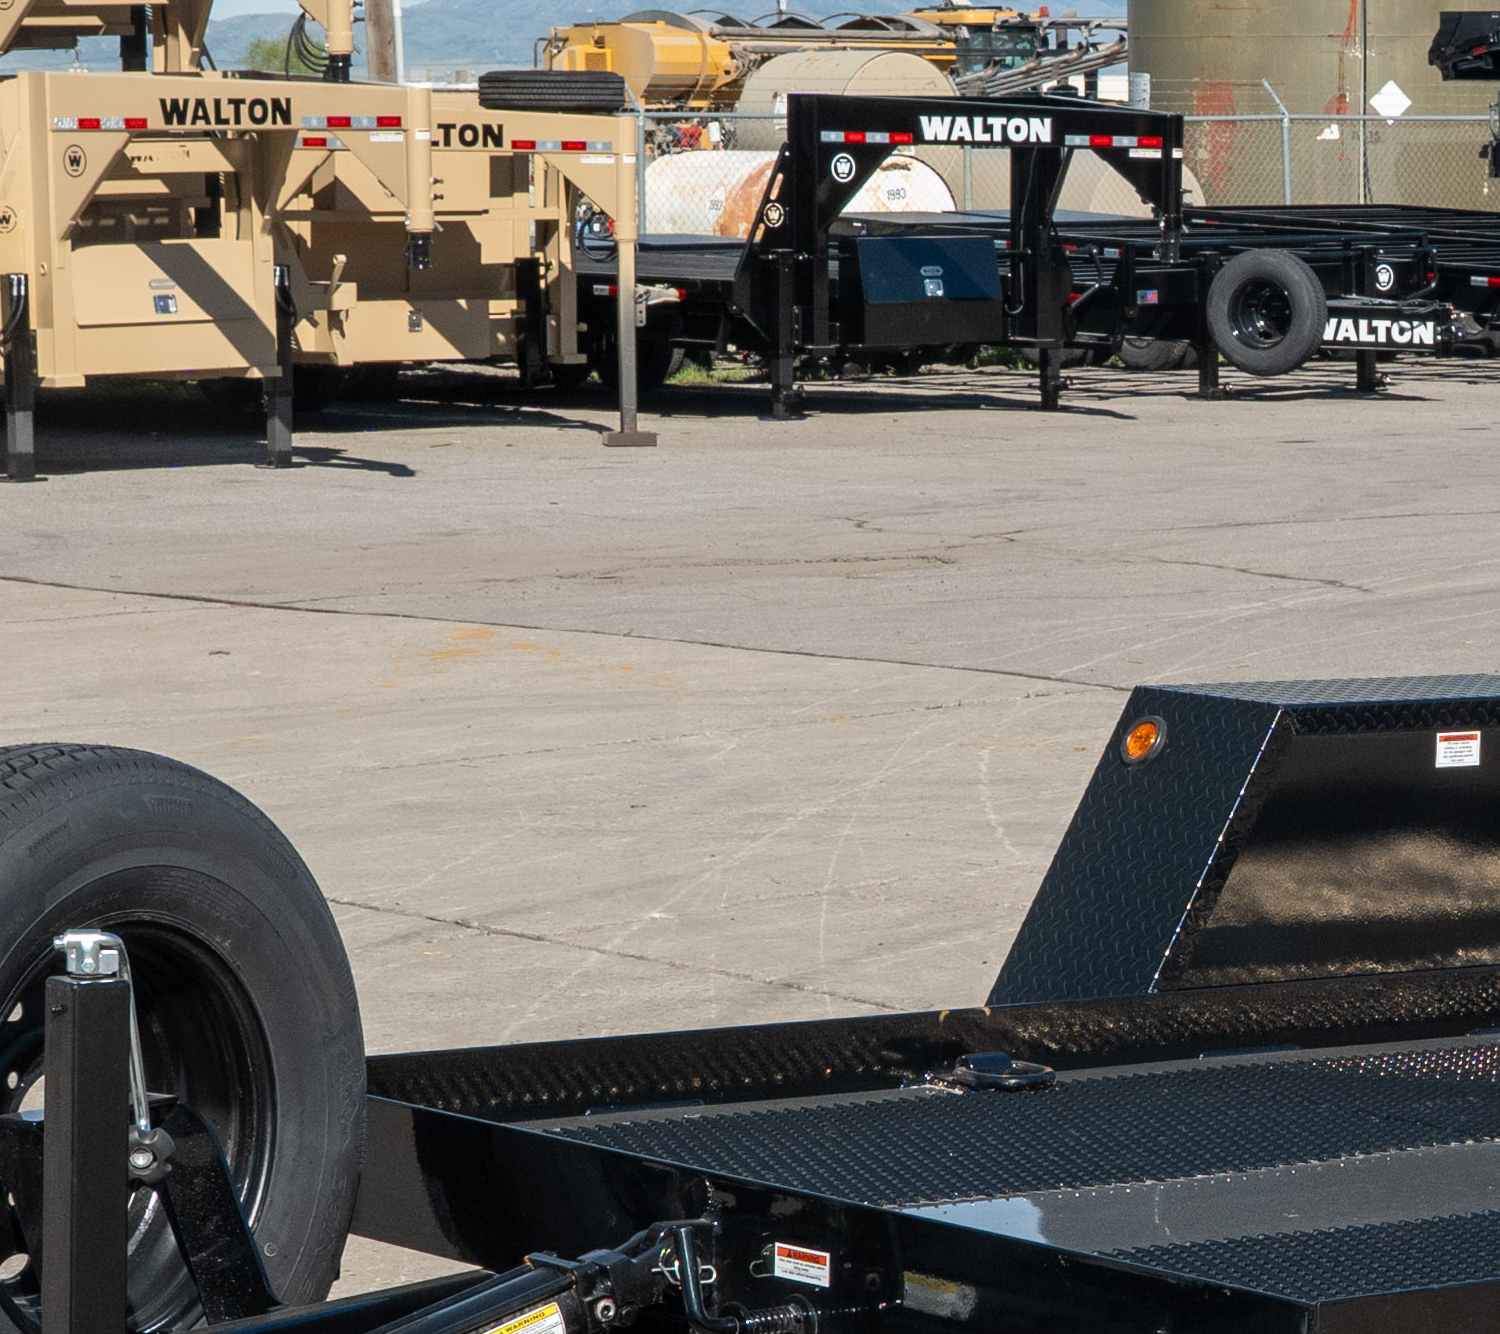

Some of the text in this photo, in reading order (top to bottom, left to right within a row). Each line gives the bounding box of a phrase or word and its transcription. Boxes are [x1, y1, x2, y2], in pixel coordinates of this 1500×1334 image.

[160, 97, 292, 125] WALTON
[431, 123, 503, 148] TON
[919, 116, 1052, 143] WALTON
[887, 187, 906, 201] 1993
[505, 1312, 545, 1332] WARNING
